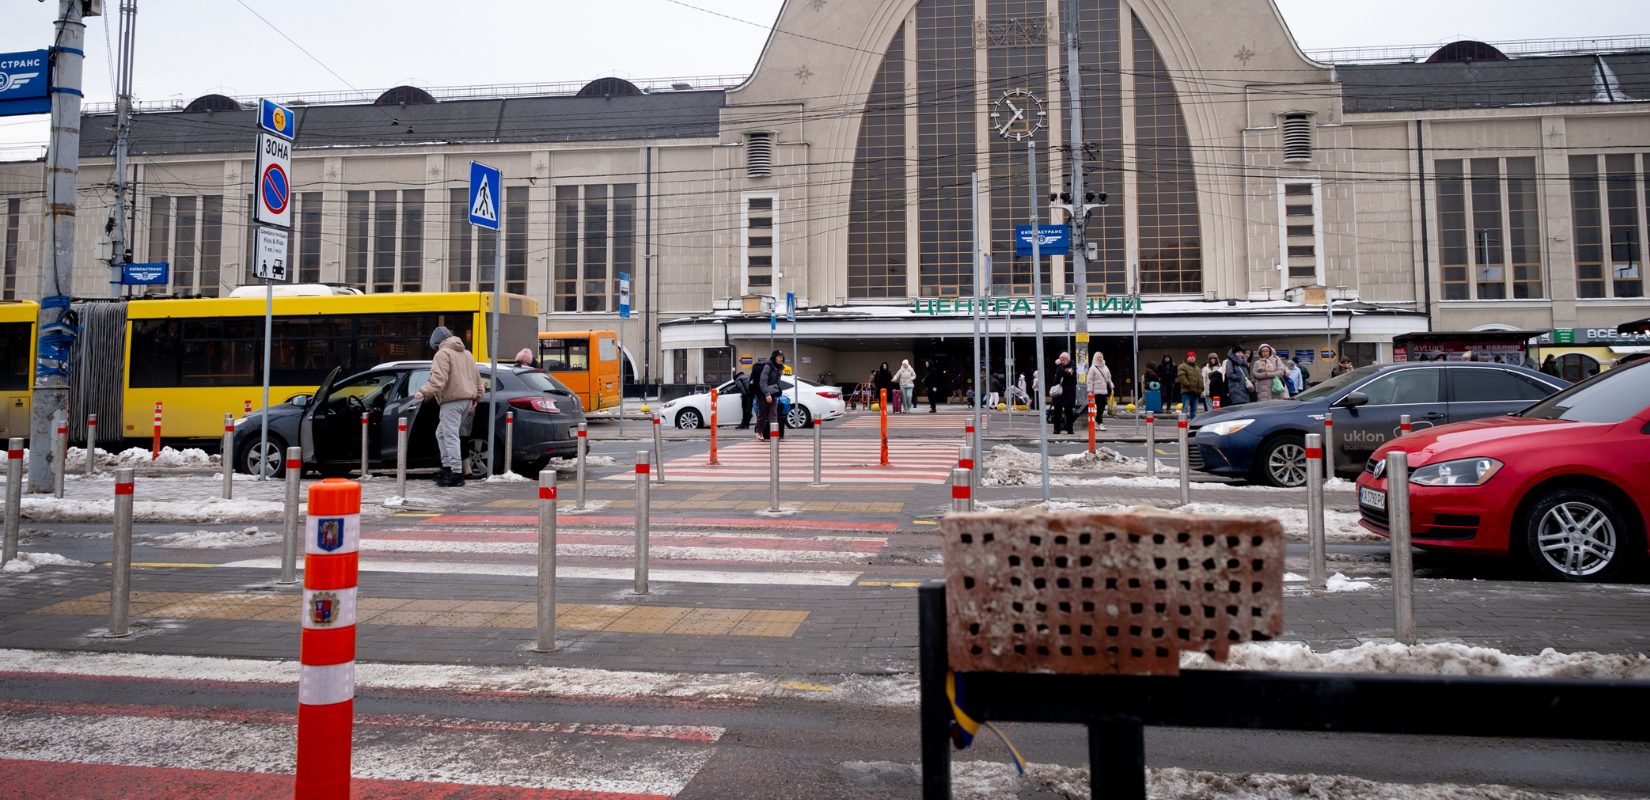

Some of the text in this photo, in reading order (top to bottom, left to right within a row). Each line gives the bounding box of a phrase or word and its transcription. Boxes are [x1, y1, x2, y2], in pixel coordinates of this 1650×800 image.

[0, 59, 40, 69] СТРАНС
[266, 139, 288, 160] ЗОНА
[1587, 329, 1617, 338] ВСЕ
[1343, 430, 1385, 442] uklon
